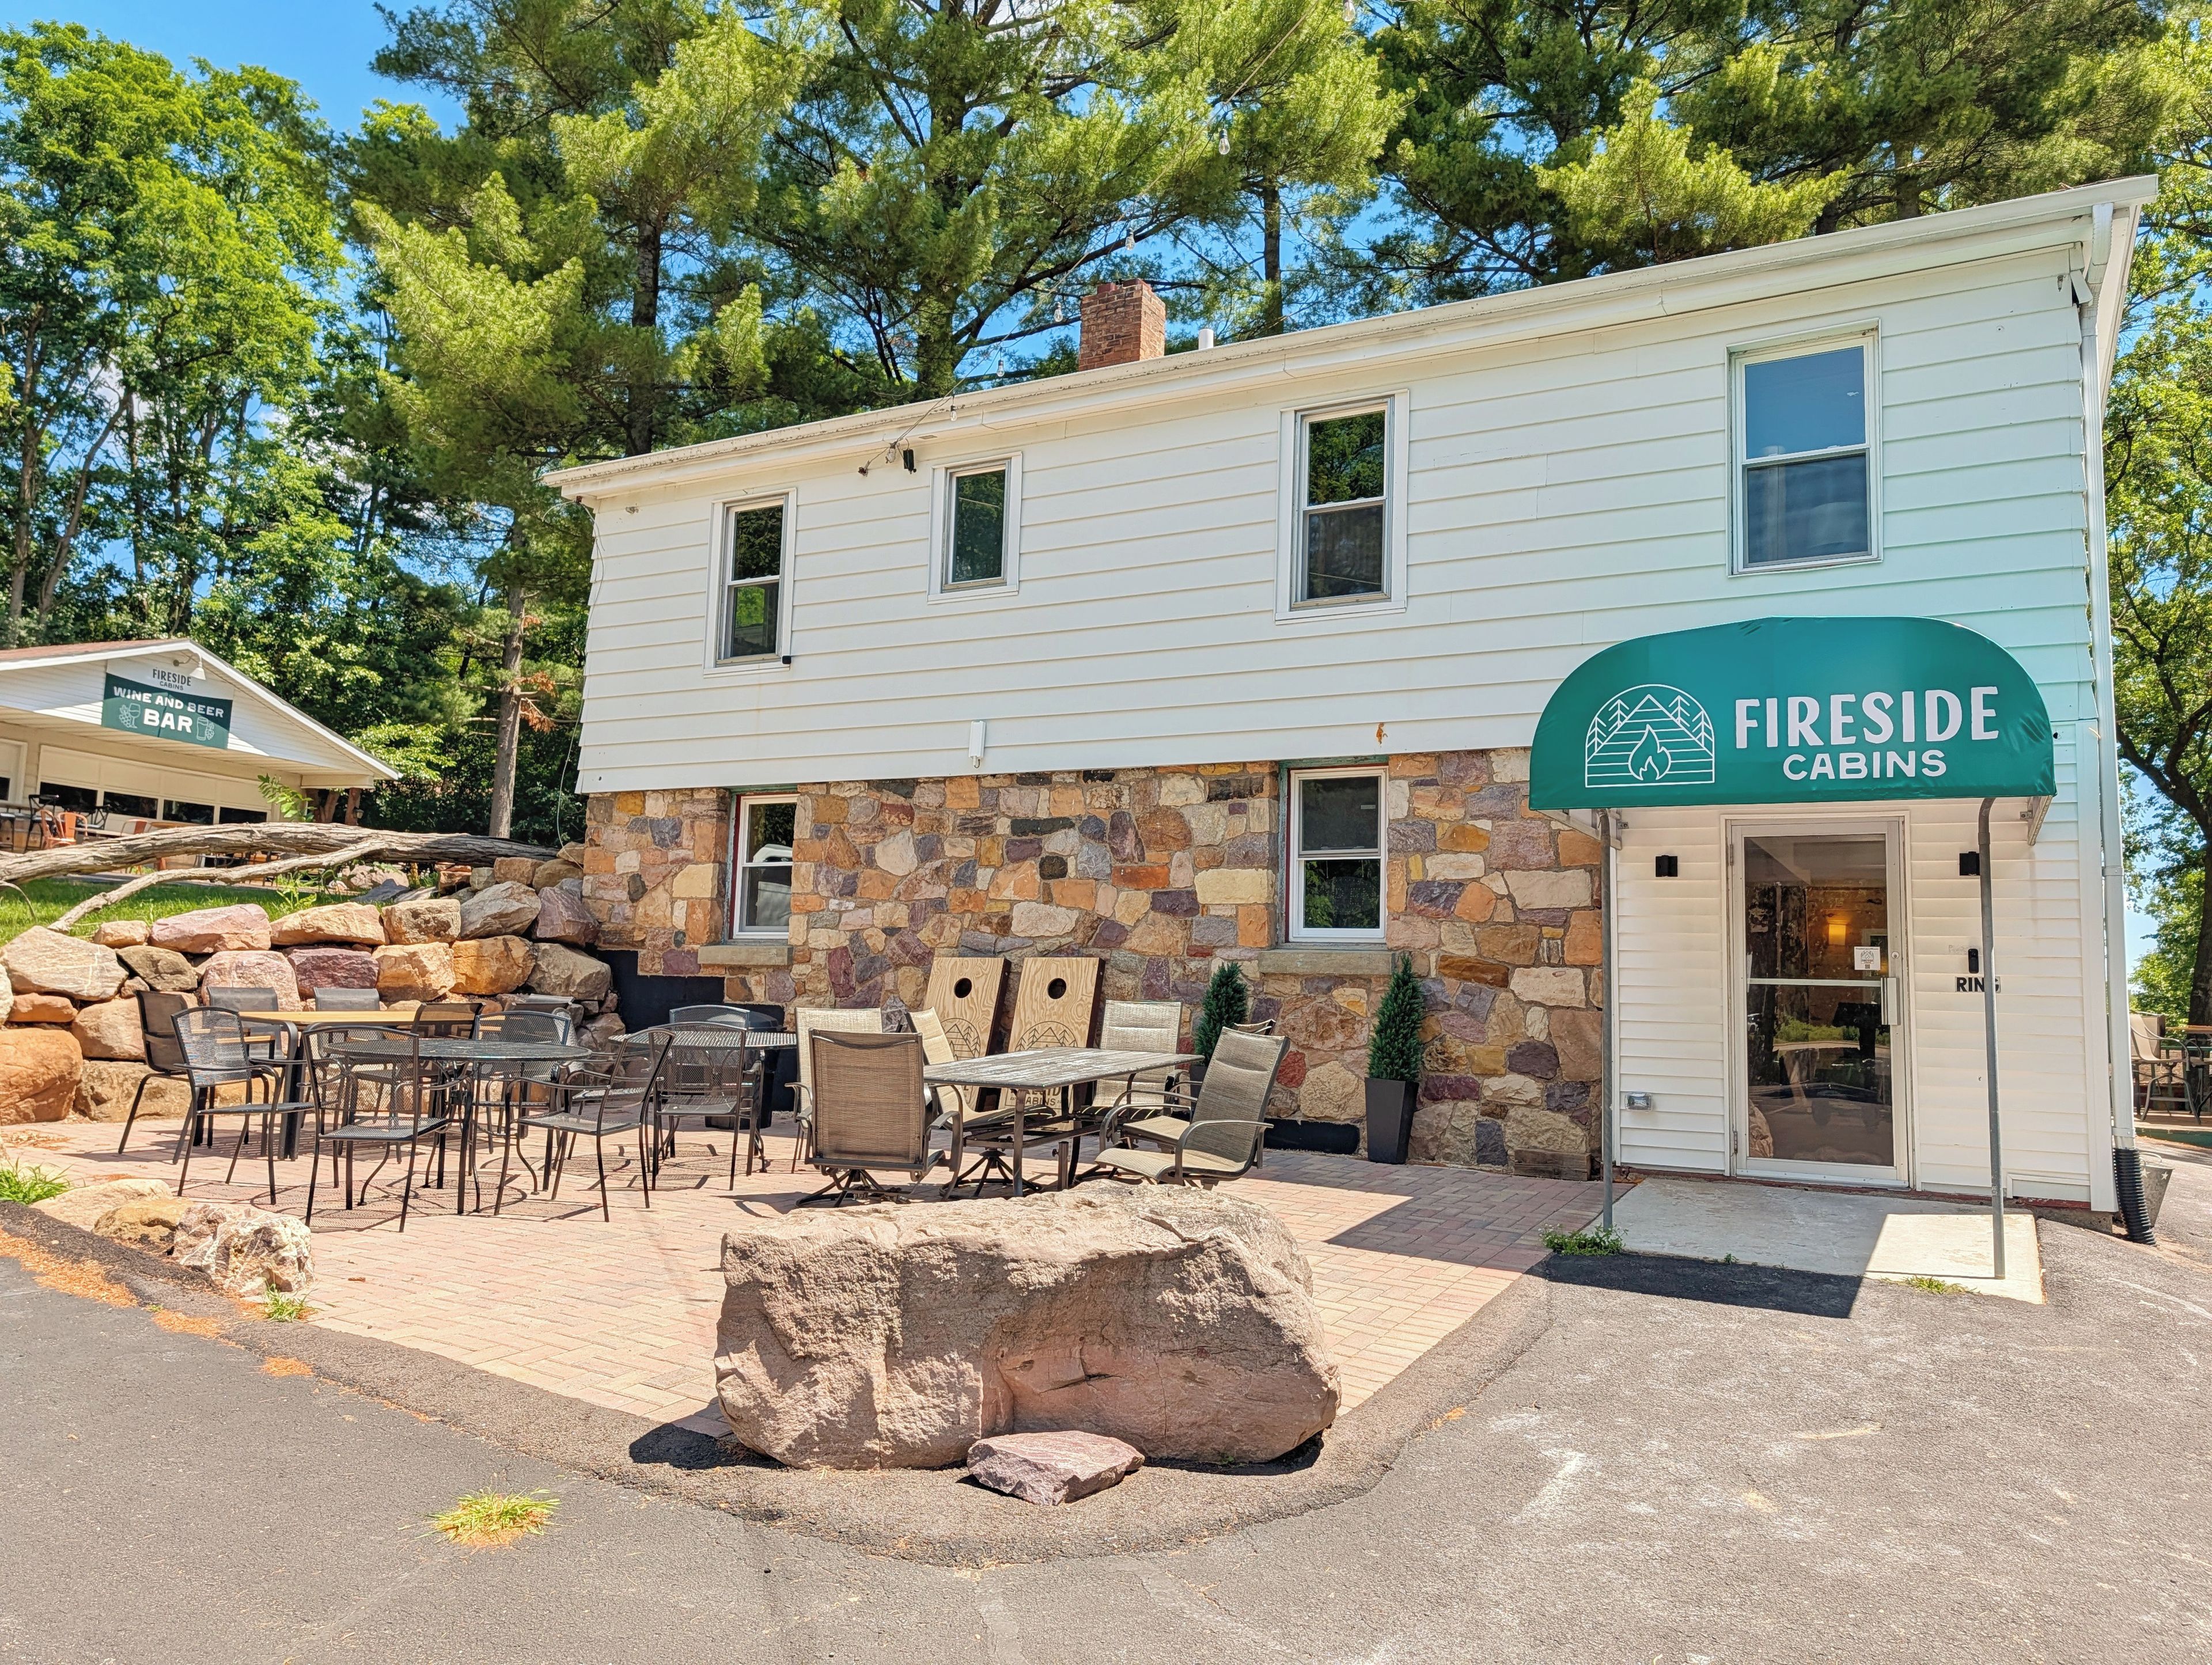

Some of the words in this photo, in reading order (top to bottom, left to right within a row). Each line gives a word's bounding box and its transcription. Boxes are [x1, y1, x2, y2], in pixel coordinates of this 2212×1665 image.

[153, 669, 191, 686] FIRESIDE
[160, 681, 184, 691] CABINS
[113, 687, 151, 703] WINE
[155, 695, 184, 710] AND
[187, 702, 224, 718] BEER
[143, 708, 193, 733] BAR
[1736, 686, 1999, 749] FIRESIDE
[1783, 749, 1946, 780] CABINS
[1025, 1096, 1056, 1106] ABINS
